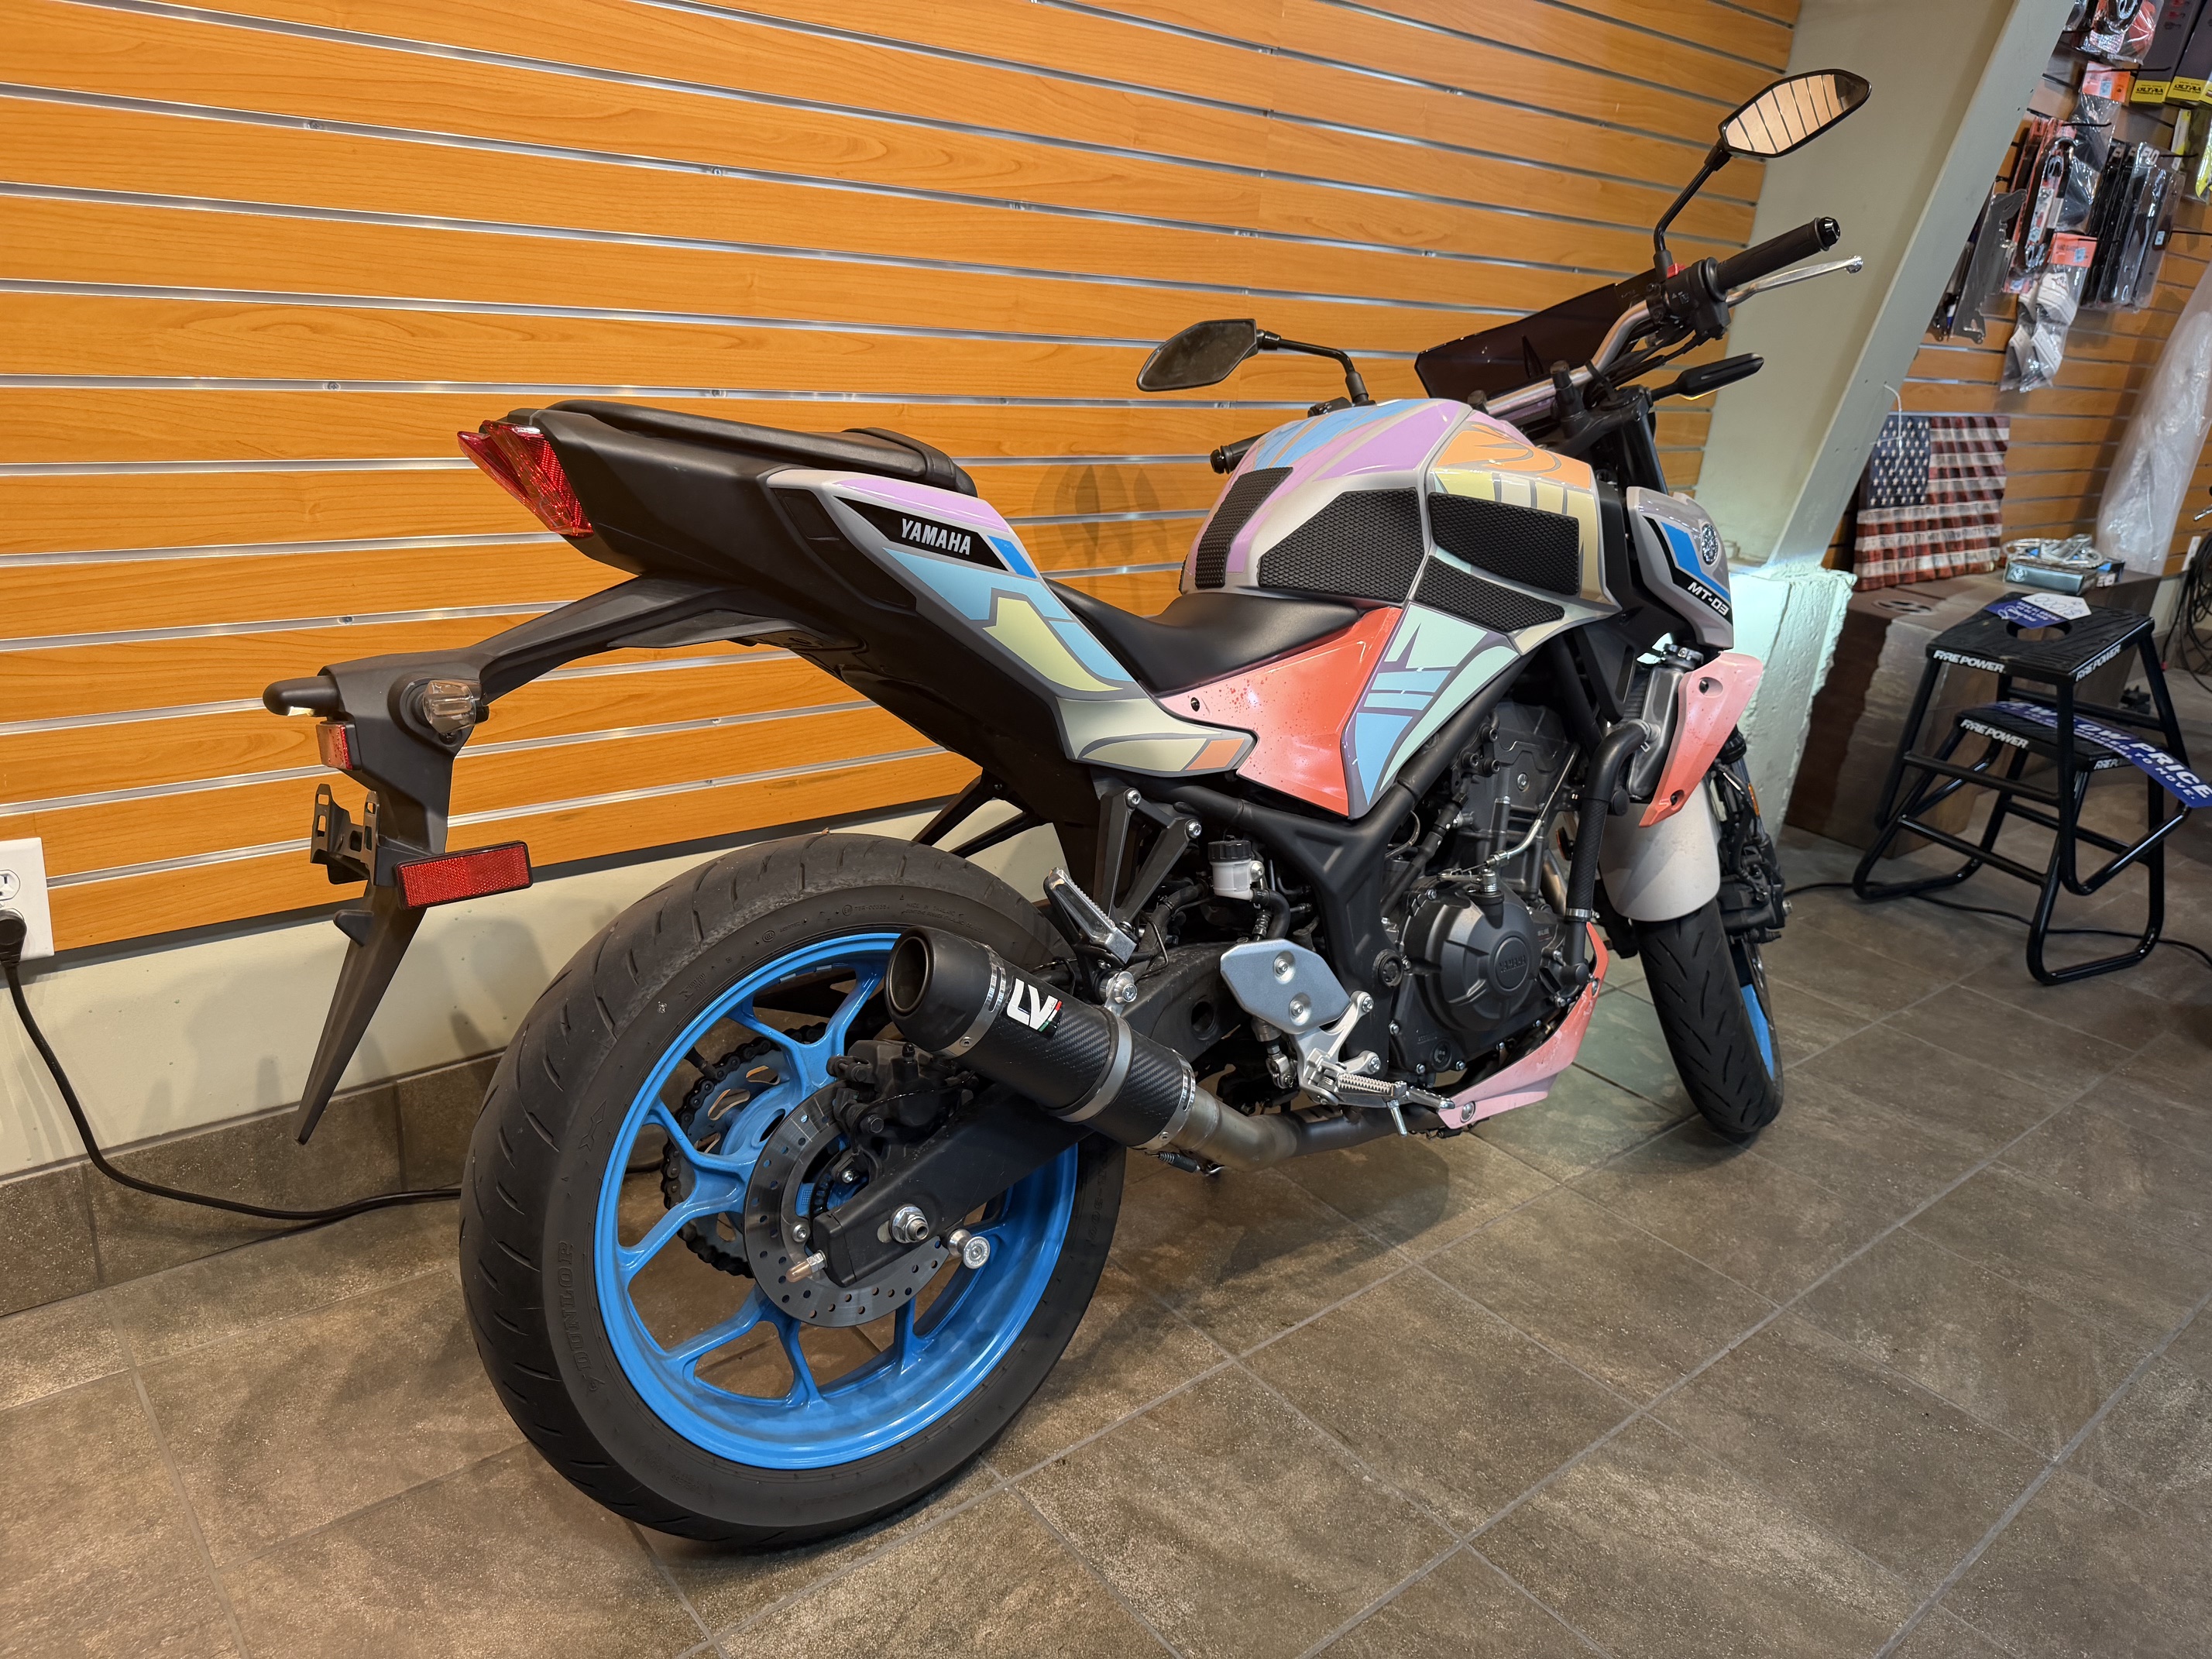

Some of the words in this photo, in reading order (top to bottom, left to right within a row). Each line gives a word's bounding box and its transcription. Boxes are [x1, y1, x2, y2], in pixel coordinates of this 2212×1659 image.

[902, 518, 971, 555] YAMAHA
[1688, 582, 1729, 616] MT-03
[1960, 654, 2006, 674] POWER
[1985, 728, 2029, 749] POWER
[2130, 742, 2212, 799] PRICE
[2135, 752, 2153, 764] TO
[2155, 768, 2196, 799] MOVE.
[1499, 955, 1527, 974] YAMAHA
[1007, 978, 1059, 1030] LV
[558, 1241, 592, 1371] DUNLOP
